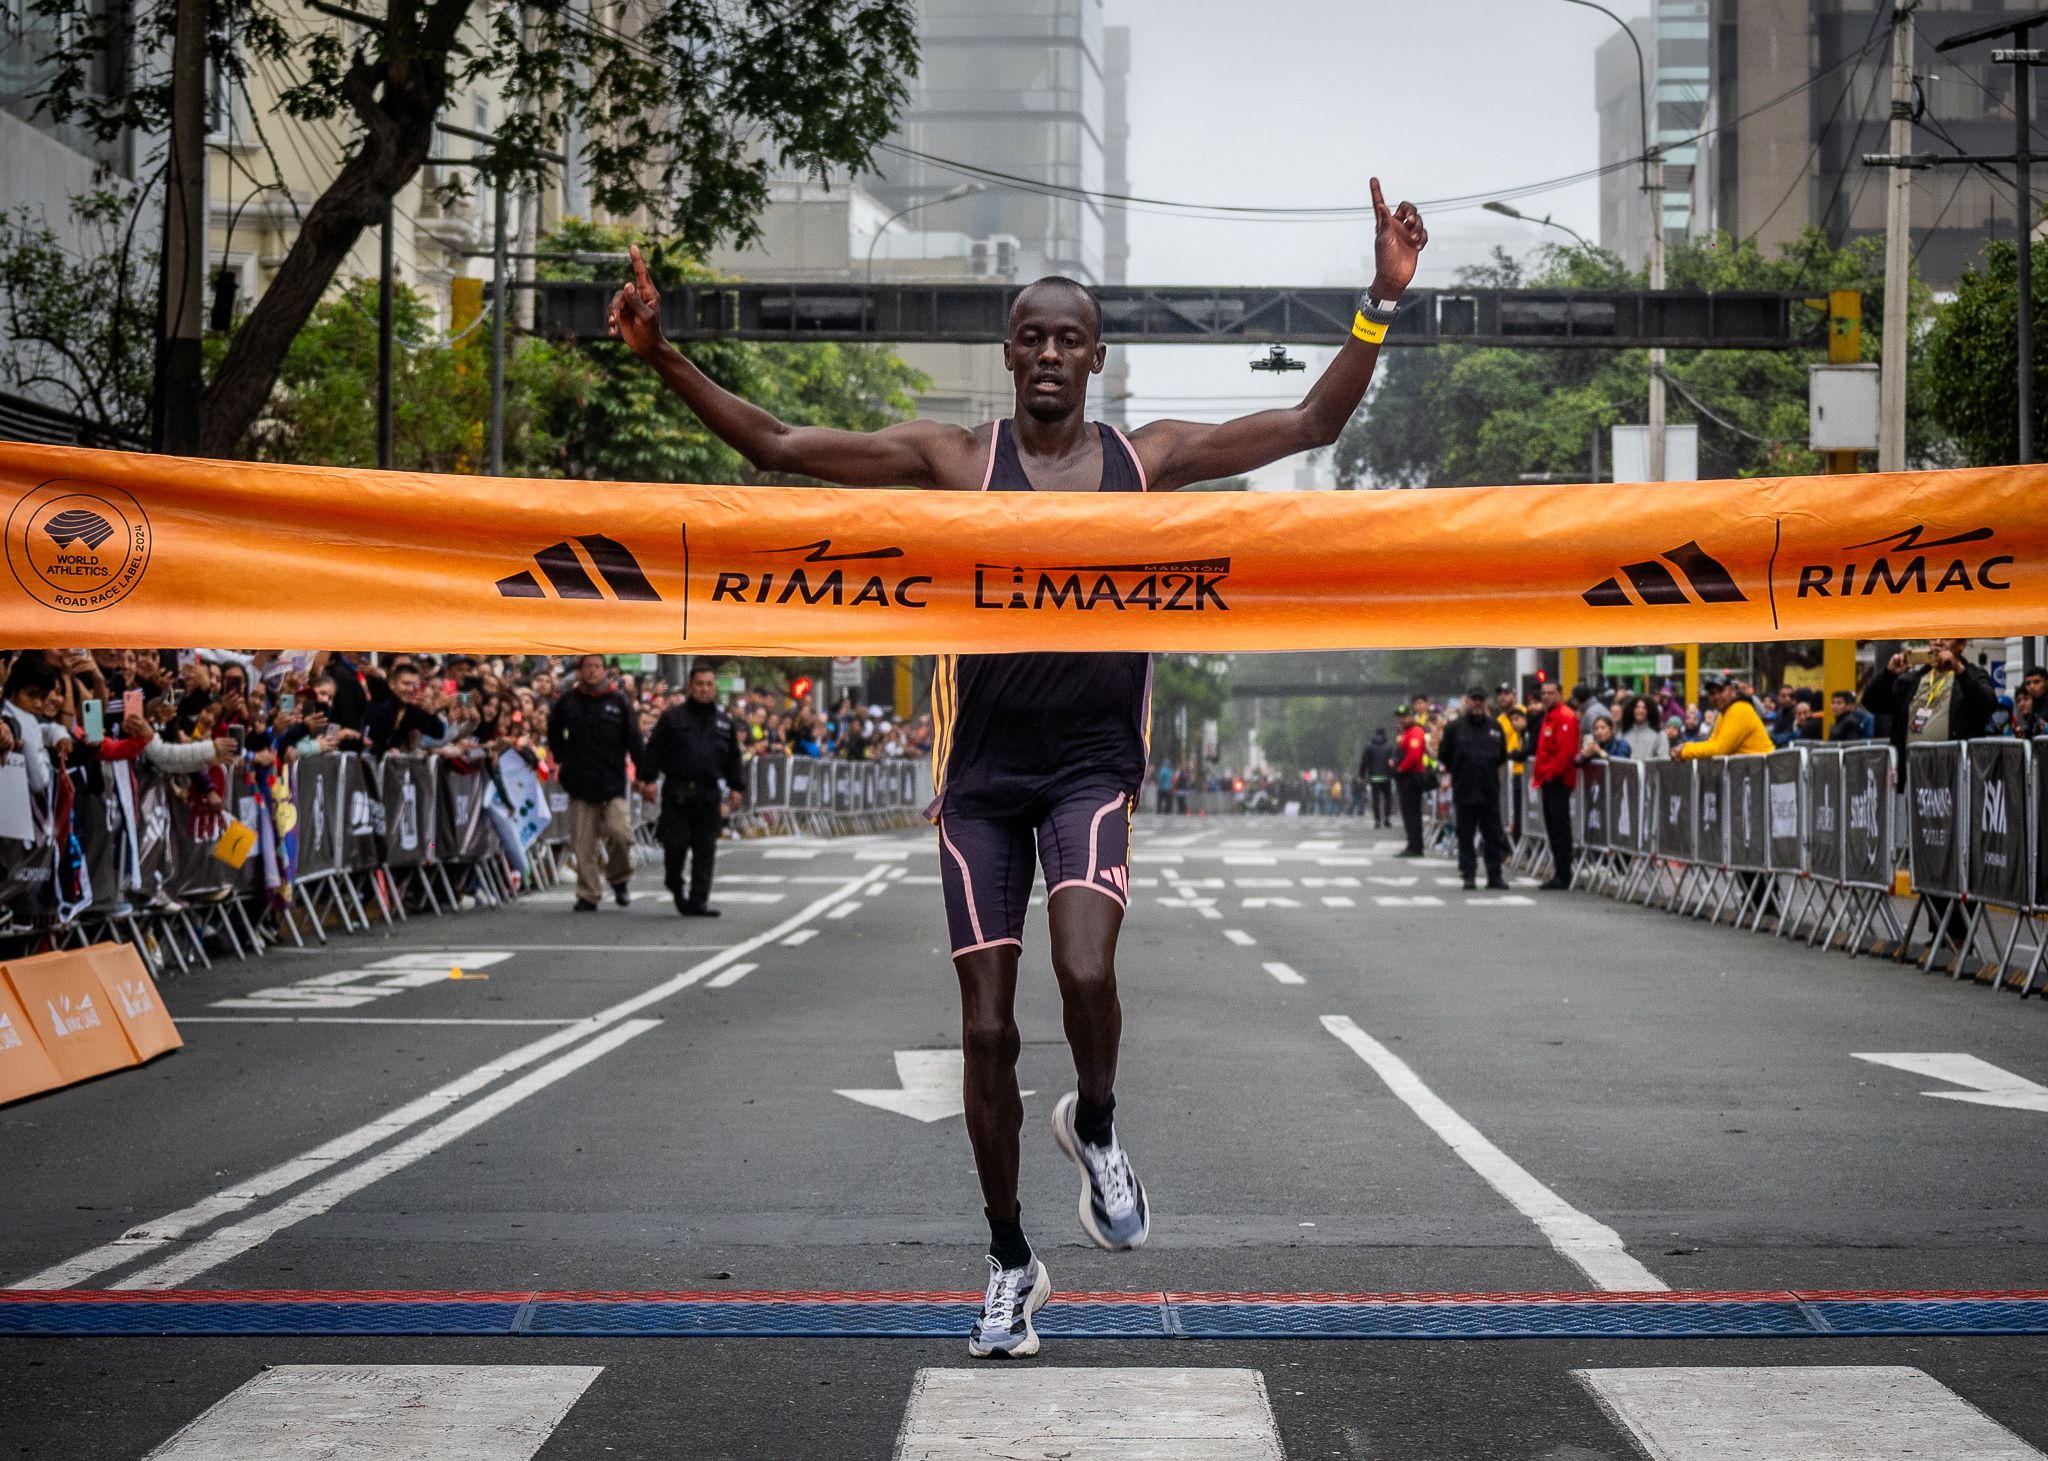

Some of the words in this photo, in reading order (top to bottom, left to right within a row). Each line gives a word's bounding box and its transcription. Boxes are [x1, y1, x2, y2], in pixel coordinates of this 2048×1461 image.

[46, 566, 109, 577] ATHLETICS
[54, 594, 88, 607] ROAD
[90, 586, 121, 605] RACE
[118, 555, 143, 589] LABEL
[135, 524, 145, 552] 2024
[56, 555, 99, 565] WORLD
[1797, 555, 2014, 598] RIMAC
[711, 568, 933, 608] RIMAC
